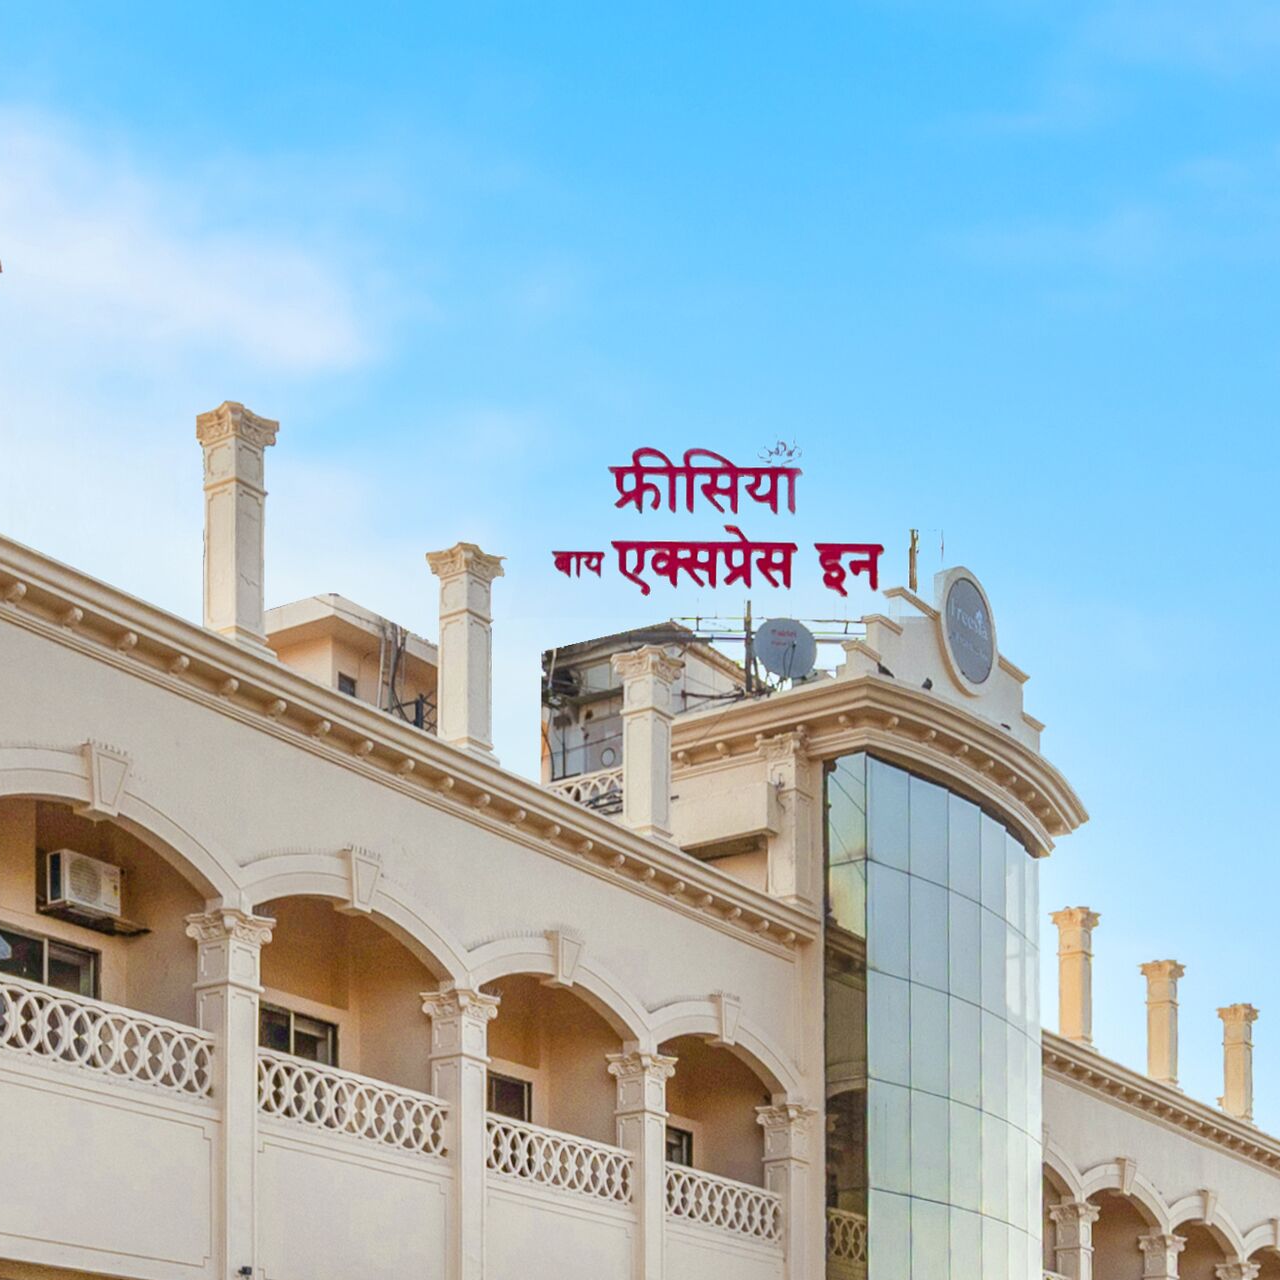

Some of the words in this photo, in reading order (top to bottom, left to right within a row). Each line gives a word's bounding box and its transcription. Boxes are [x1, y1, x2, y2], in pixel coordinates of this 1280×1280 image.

[608, 447, 803, 514] फ्रीसिया
[552, 550, 605, 577] बाय
[611, 524, 798, 596] एक्सप्रेस
[814, 542, 885, 598] इन
